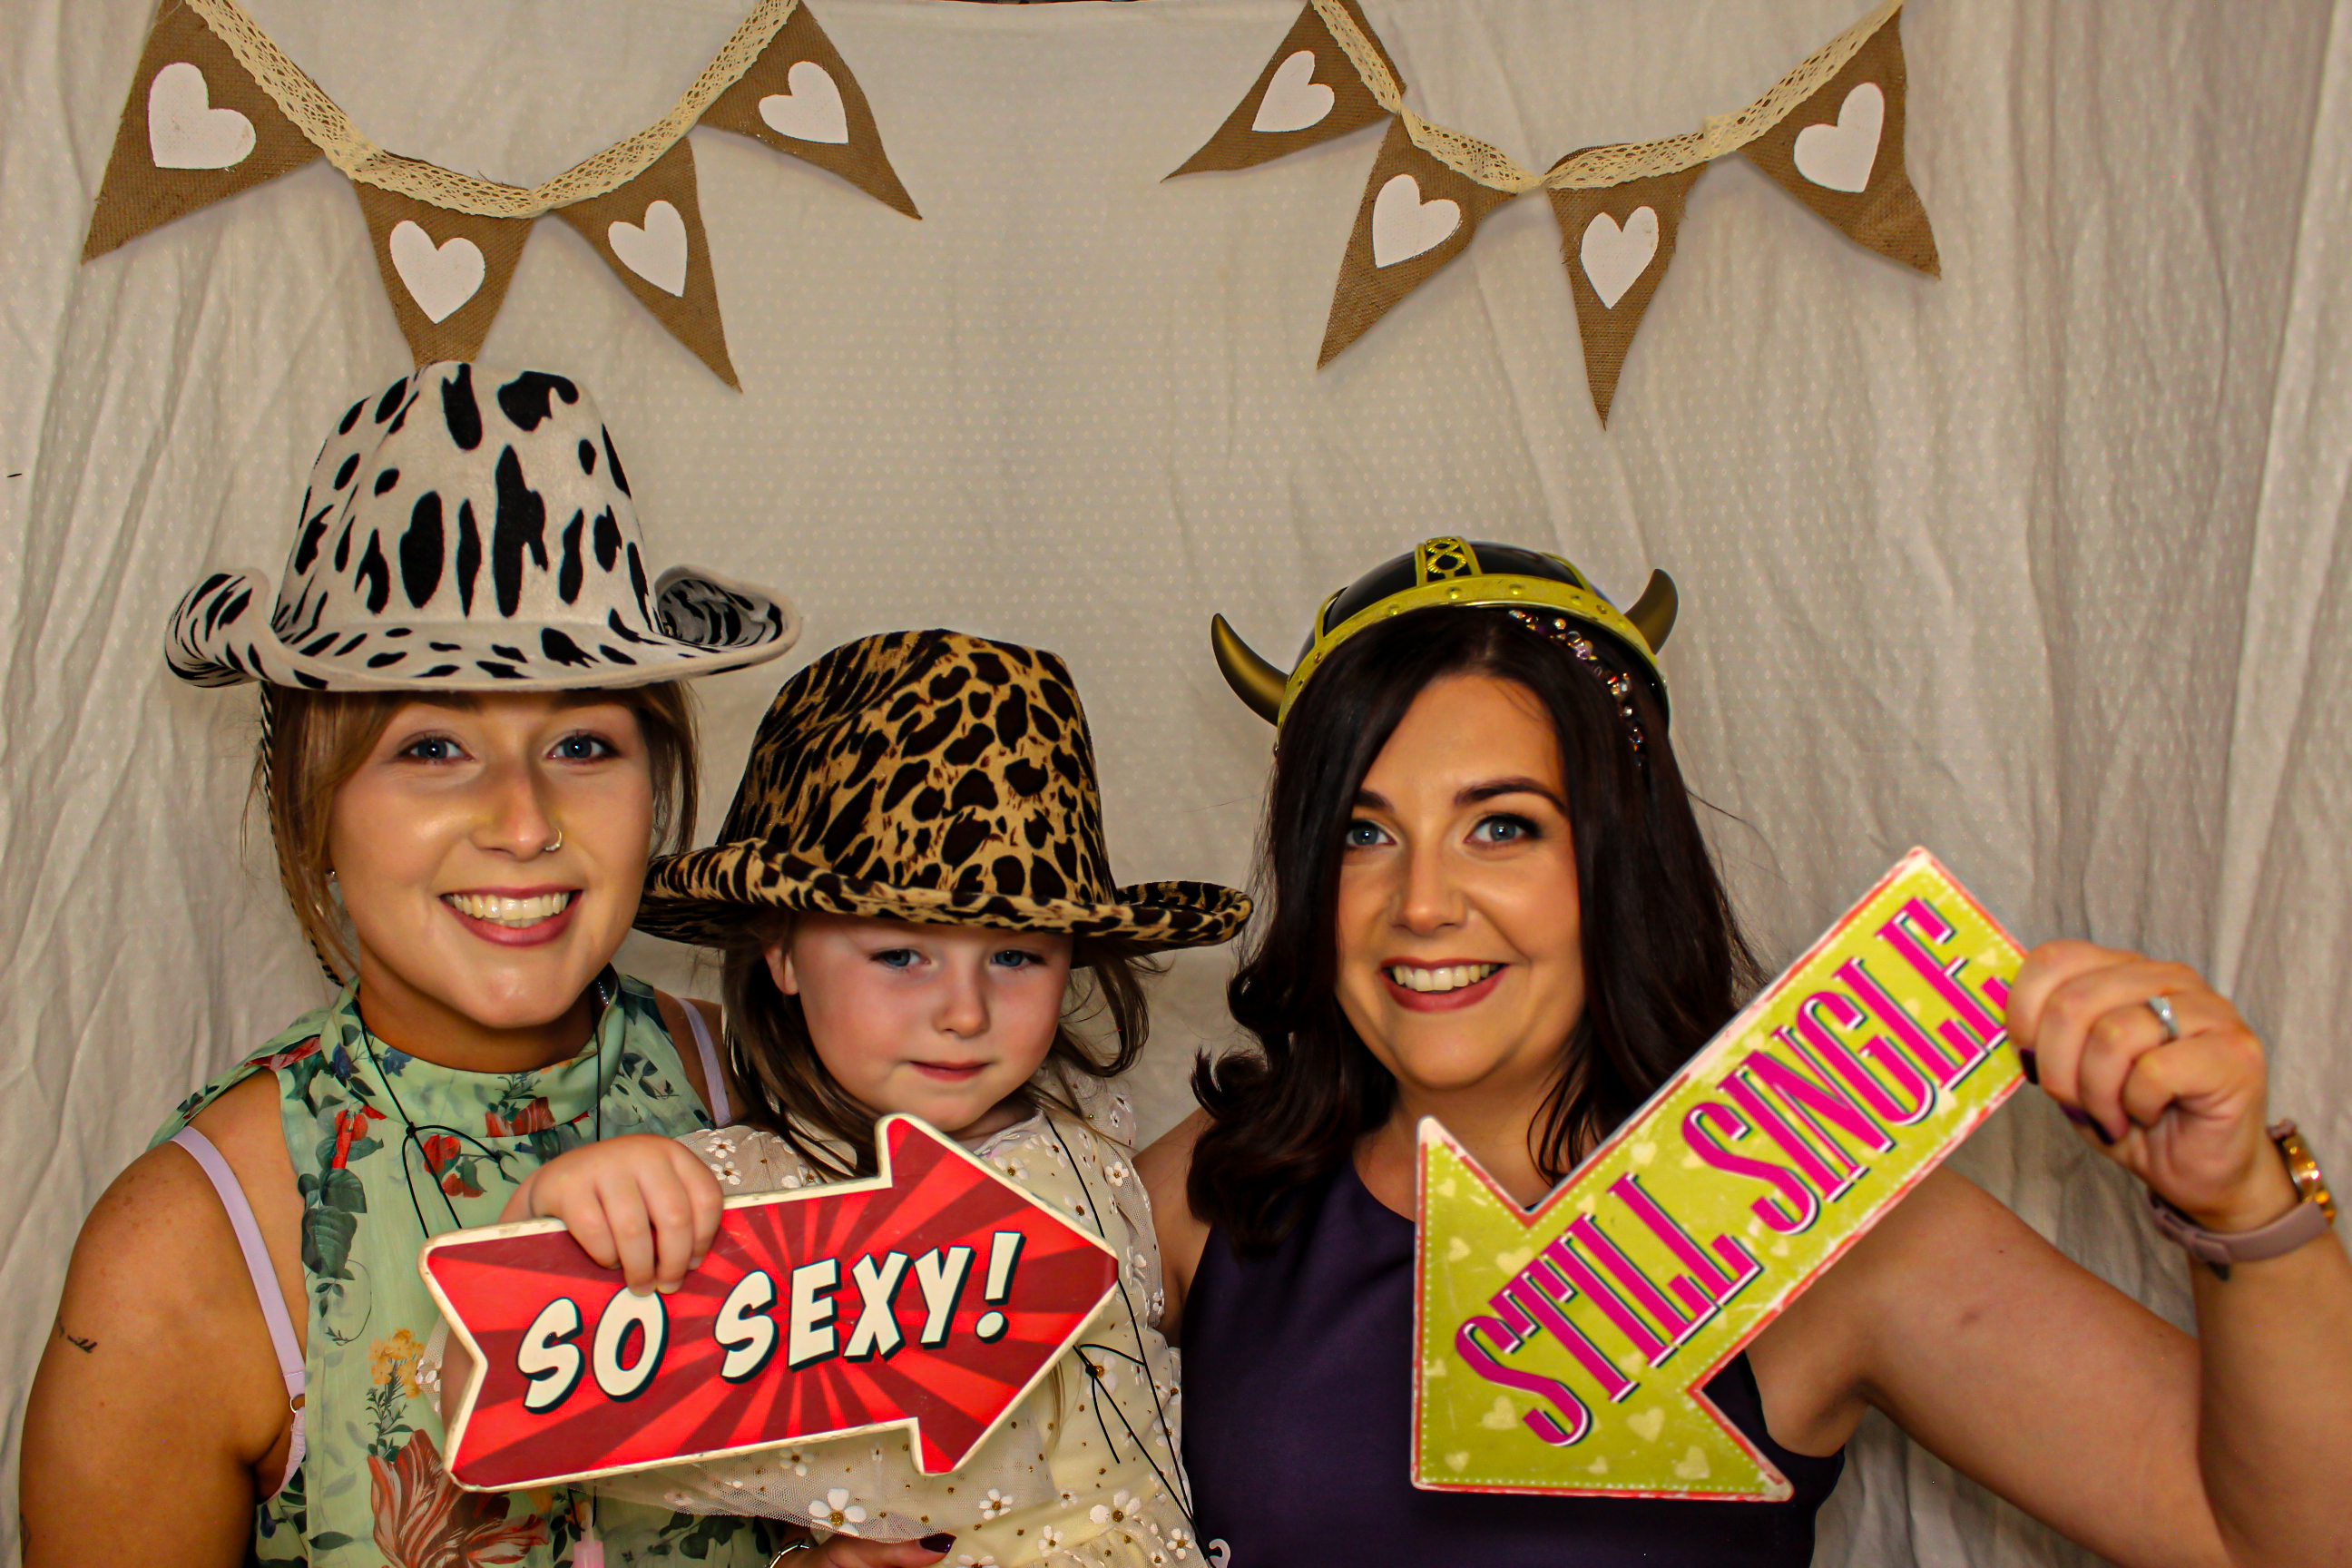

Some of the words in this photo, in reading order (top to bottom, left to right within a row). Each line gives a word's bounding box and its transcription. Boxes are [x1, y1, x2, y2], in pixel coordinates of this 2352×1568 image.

[517, 1287, 670, 1414] SO
[713, 1231, 1025, 1384] SEXY!
[1455, 1171, 1763, 1446] STILL
[1681, 897, 2012, 1235] SINGLE
